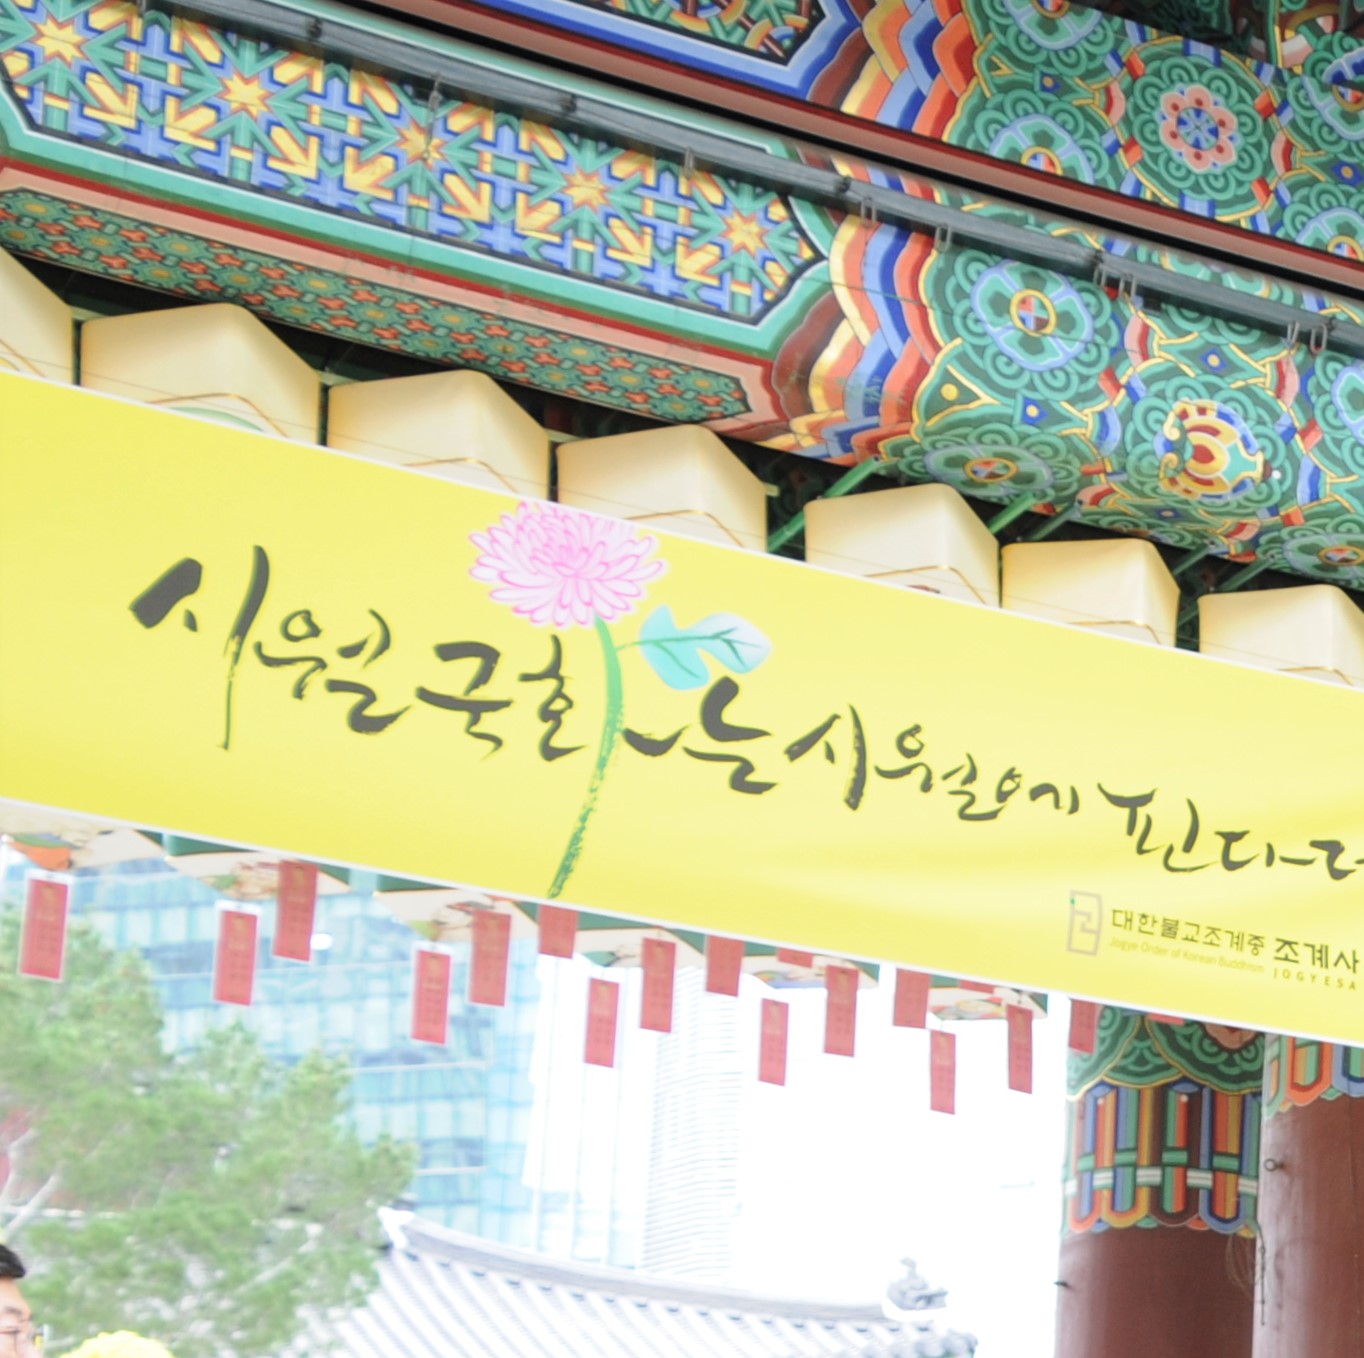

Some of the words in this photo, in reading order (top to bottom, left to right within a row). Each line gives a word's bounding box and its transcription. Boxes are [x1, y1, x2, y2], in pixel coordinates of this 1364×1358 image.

[127, 544, 412, 751] 시월
[784, 703, 1080, 822] 시월에
[1140, 941, 1168, 956] Order
[1183, 950, 1217, 965] Korean
[1273, 937, 1360, 974] 조계사
[1273, 967, 1357, 991] JOGYESA
